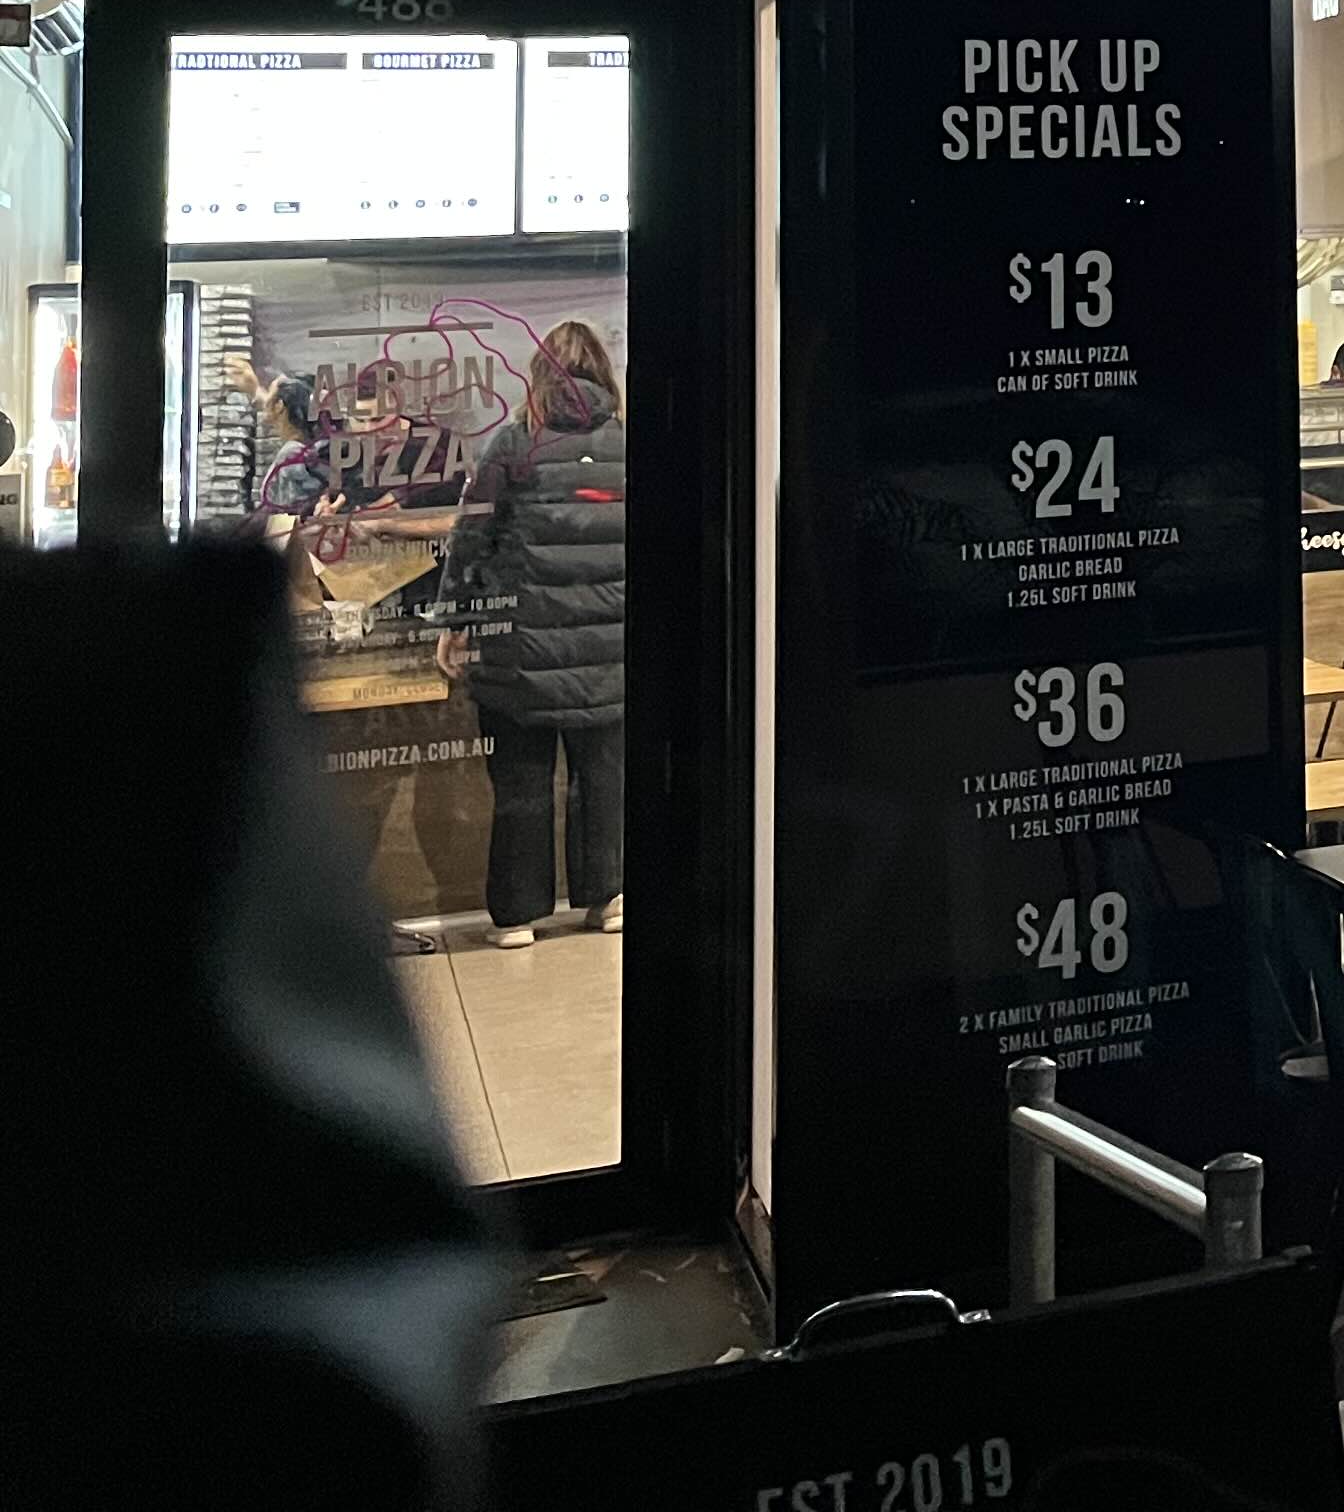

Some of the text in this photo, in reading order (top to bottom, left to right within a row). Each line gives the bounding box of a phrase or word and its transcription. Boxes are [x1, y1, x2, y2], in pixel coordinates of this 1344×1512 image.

[260, 54, 301, 69] PIZZA
[373, 54, 480, 69] GOURMET PIZZA
[963, 39, 1160, 94] PICK UP
[942, 103, 1182, 160] SPECIALS
[1009, 250, 1113, 329] $13
[1008, 345, 1129, 367] 1 X SMALL PIZZA
[307, 356, 494, 422] ALBION
[997, 369, 1138, 393] CAN OF SOFT DRINK
[327, 425, 477, 495] PIZZA
[1011, 436, 1120, 518] $24
[960, 527, 1180, 561] 1 X LARGE TRADITIONAL PIZZA
[1018, 557, 1123, 582] GARLIC BREAD
[1007, 580, 1137, 608] 1.25L SOFT DRINK
[1014, 663, 1124, 747] $36
[962, 752, 1183, 795] 1 X LARGE TRADITIONAL PIZZA
[975, 779, 1172, 819] 1 X PASTA & GARLIC BREAD
[1010, 808, 1140, 840] 1.25L SOFT DRINK
[1016, 892, 1128, 979] $48
[959, 982, 1190, 1033] 2 X FAMILY TRADITIONAL PIZZA
[999, 1013, 1153, 1054] SMALL GARLIC PIZZA
[1057, 1040, 1144, 1070] SOFT DRINK
[876, 1437, 1012, 1512] 2019
